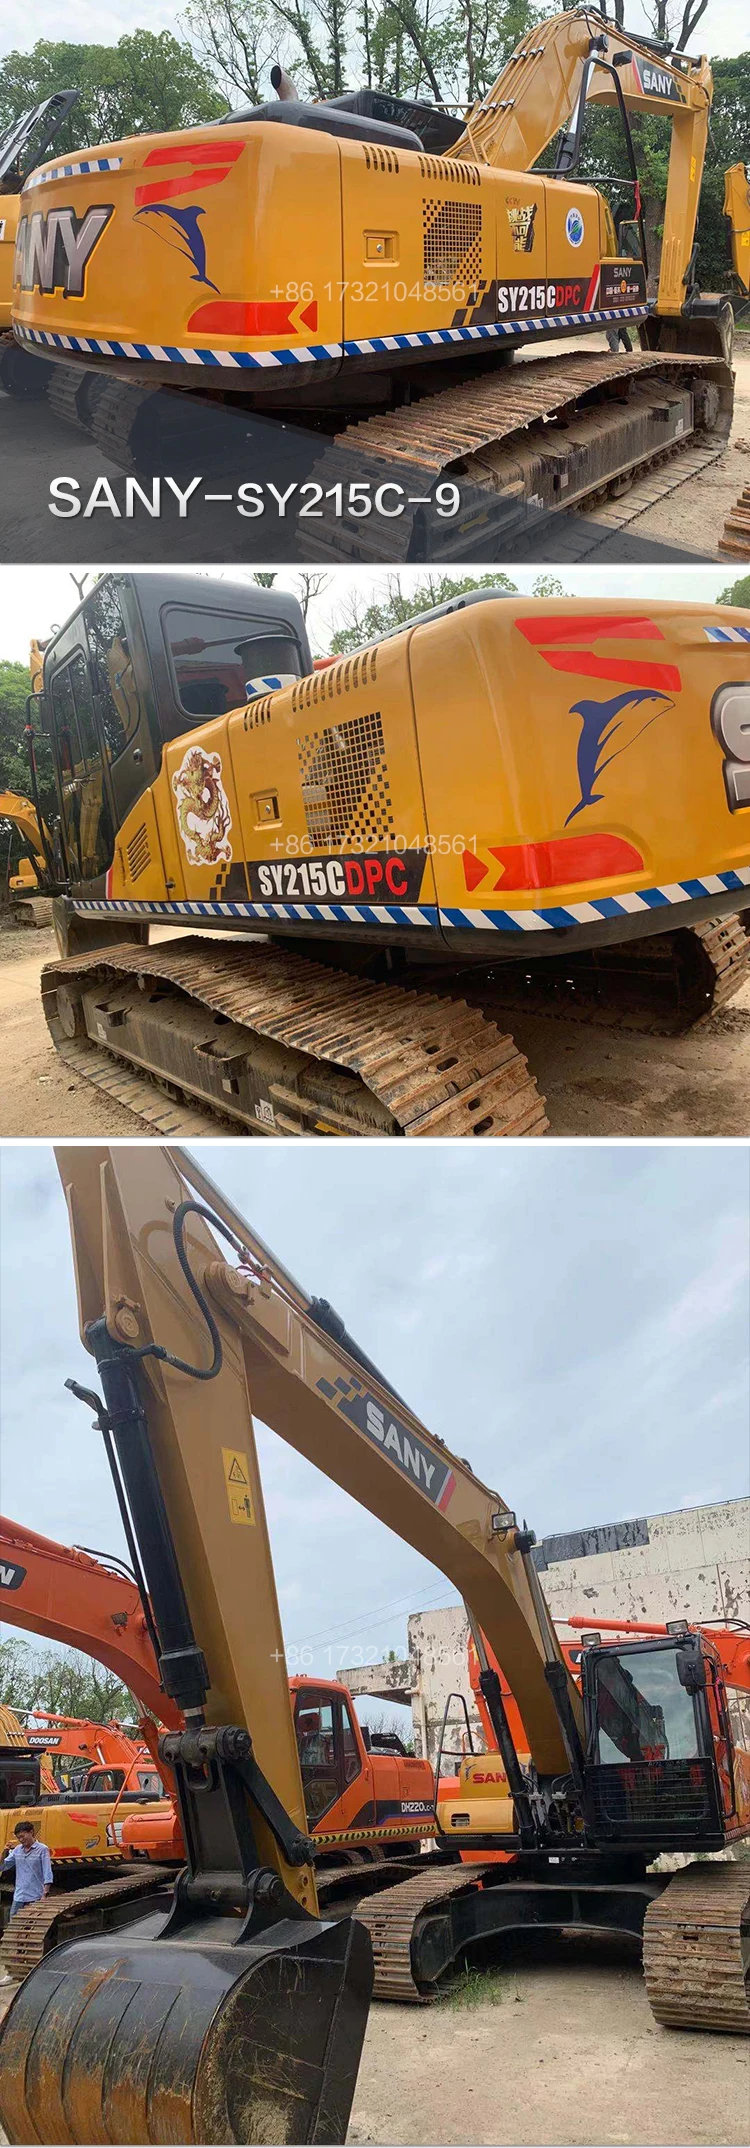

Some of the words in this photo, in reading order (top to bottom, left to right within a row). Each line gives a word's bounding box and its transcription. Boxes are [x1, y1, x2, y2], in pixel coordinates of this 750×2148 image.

[642, 69, 673, 96] SANY
[613, 267, 632, 278] SANY
[498, 284, 581, 314] SY215CDPC
[257, 857, 408, 897] SY215CDPC
[366, 1400, 436, 1490] SANY
[28, 1736, 60, 1746] DOOSAN
[472, 1772, 507, 1784] SAN
